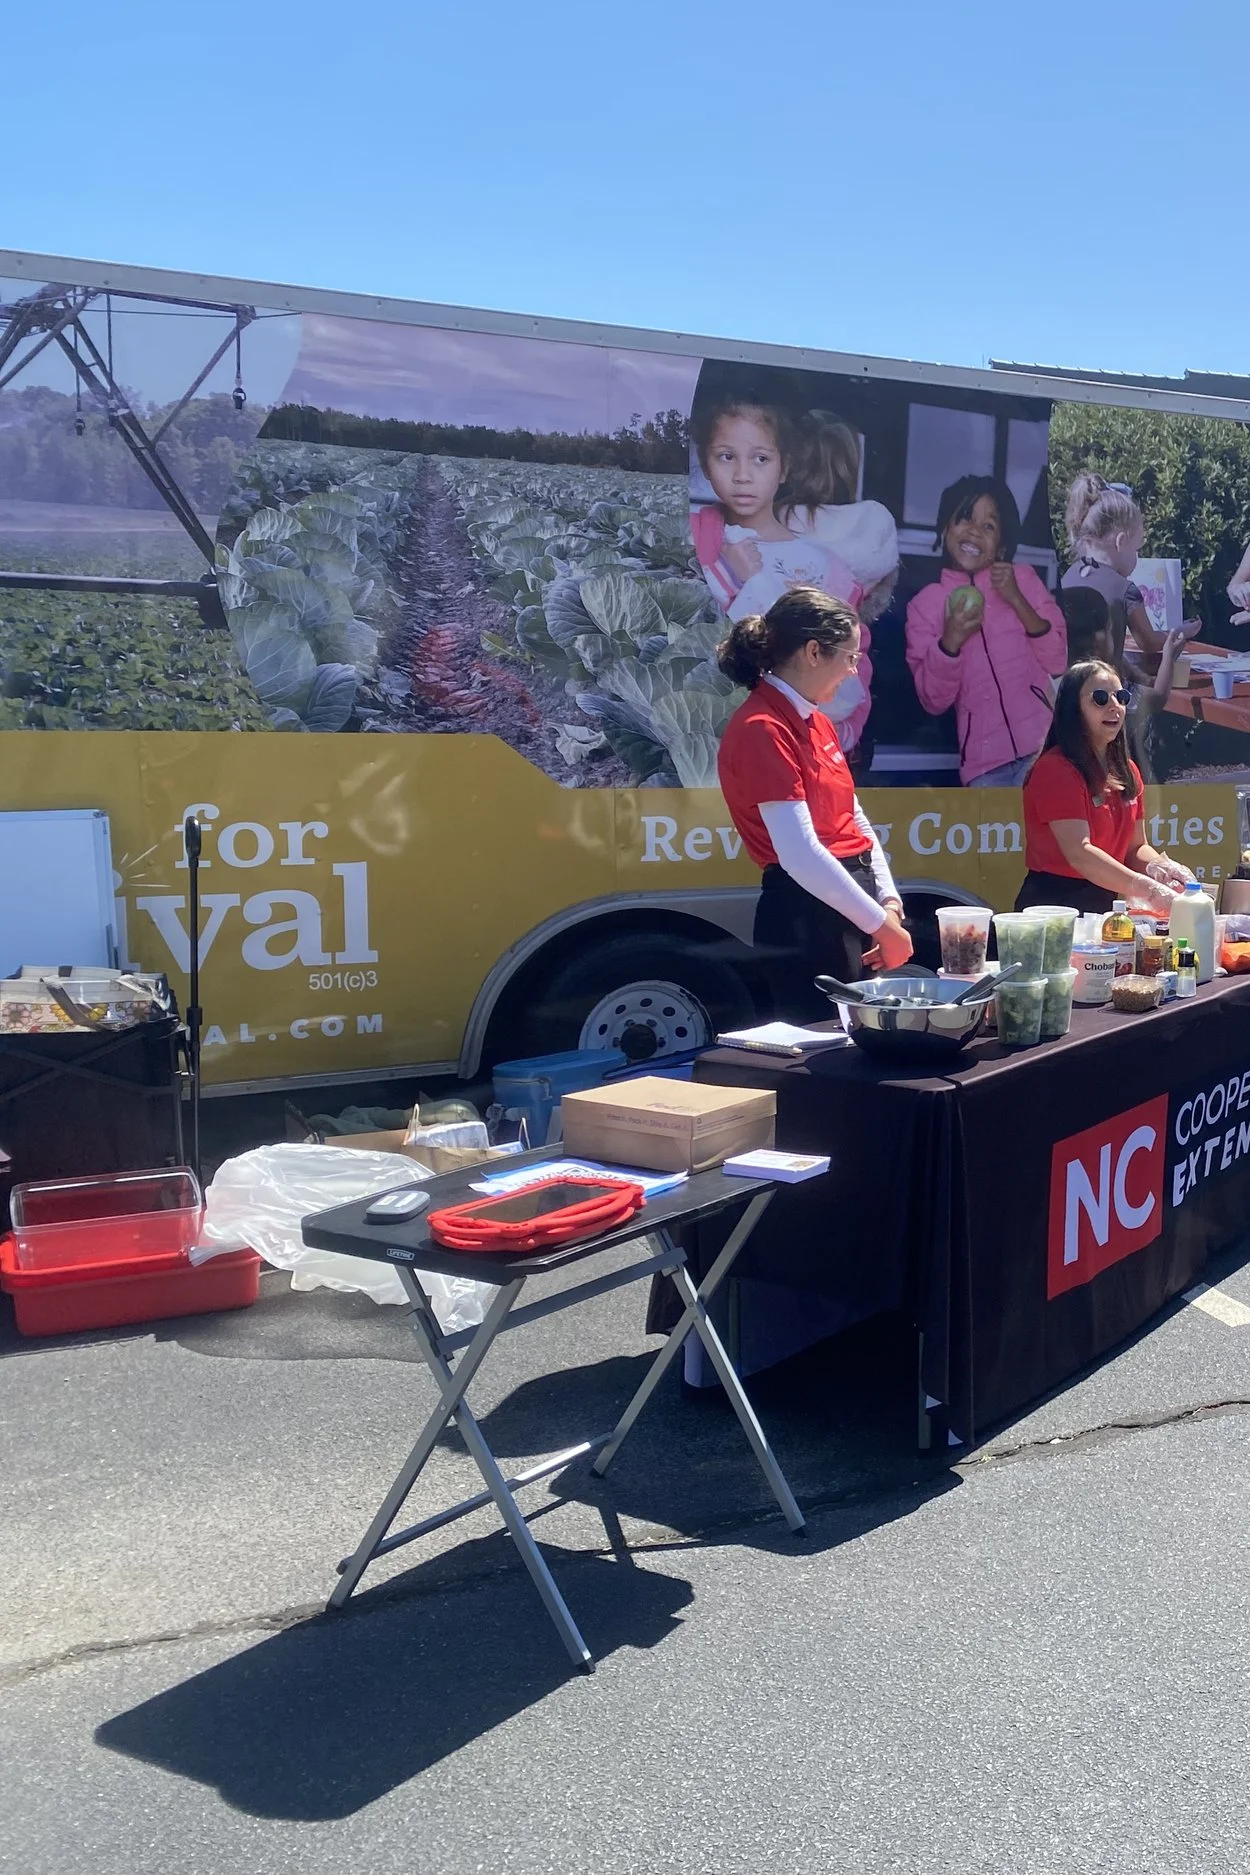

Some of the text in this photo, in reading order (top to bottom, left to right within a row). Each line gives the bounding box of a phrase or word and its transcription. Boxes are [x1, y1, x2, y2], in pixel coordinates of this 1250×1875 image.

[174, 803, 329, 869] for
[908, 803, 1225, 856] Comties
[308, 970, 379, 992] 501(c)3
[1063, 1125, 1157, 1267] NC
